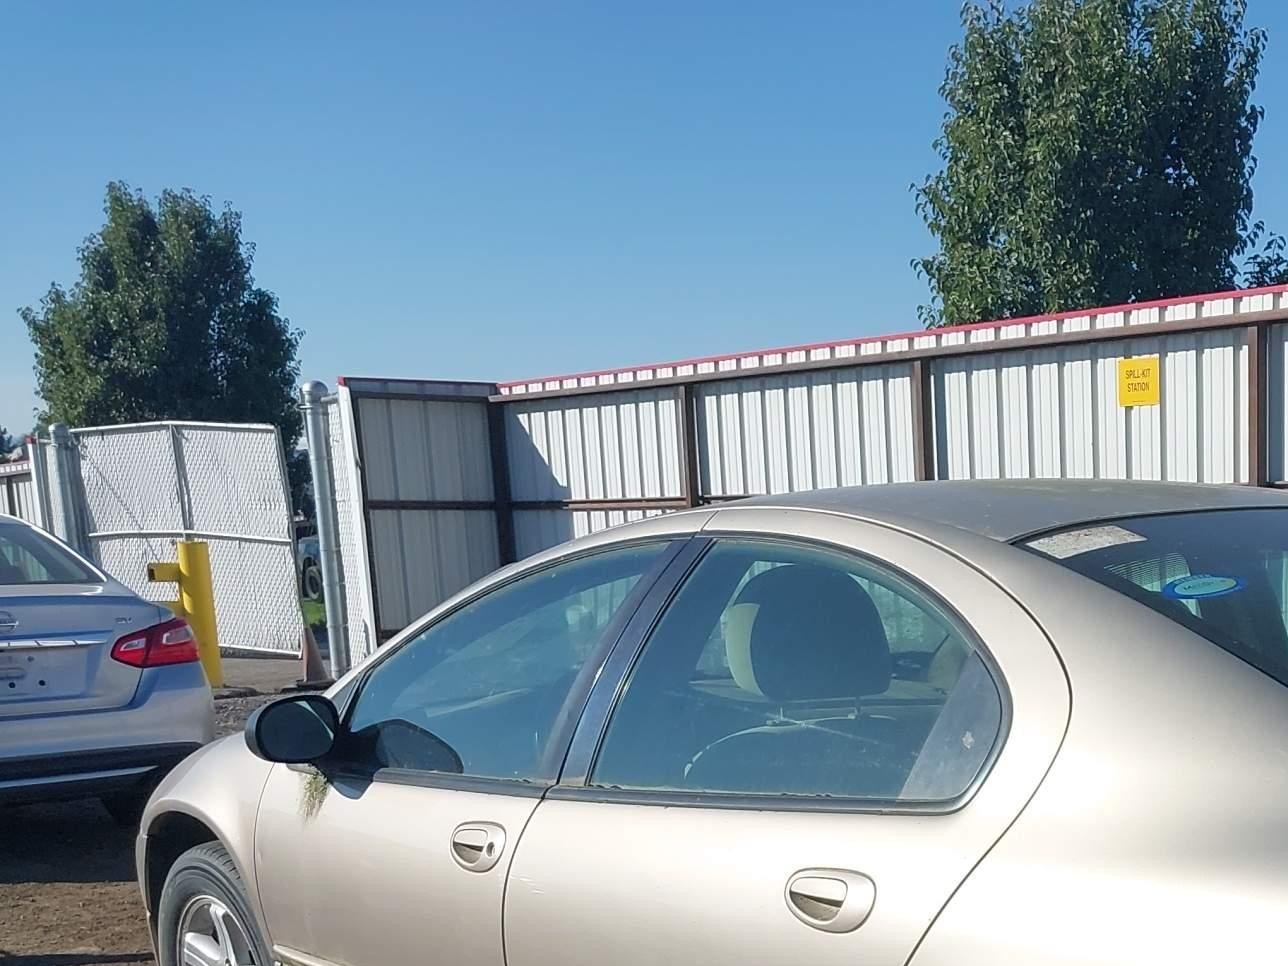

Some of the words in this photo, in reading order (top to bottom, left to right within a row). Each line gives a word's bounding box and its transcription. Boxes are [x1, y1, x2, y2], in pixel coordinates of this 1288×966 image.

[1125, 369, 1140, 380] SPILL
[1141, 367, 1151, 378] KIT
[1127, 381, 1150, 393] STATION
